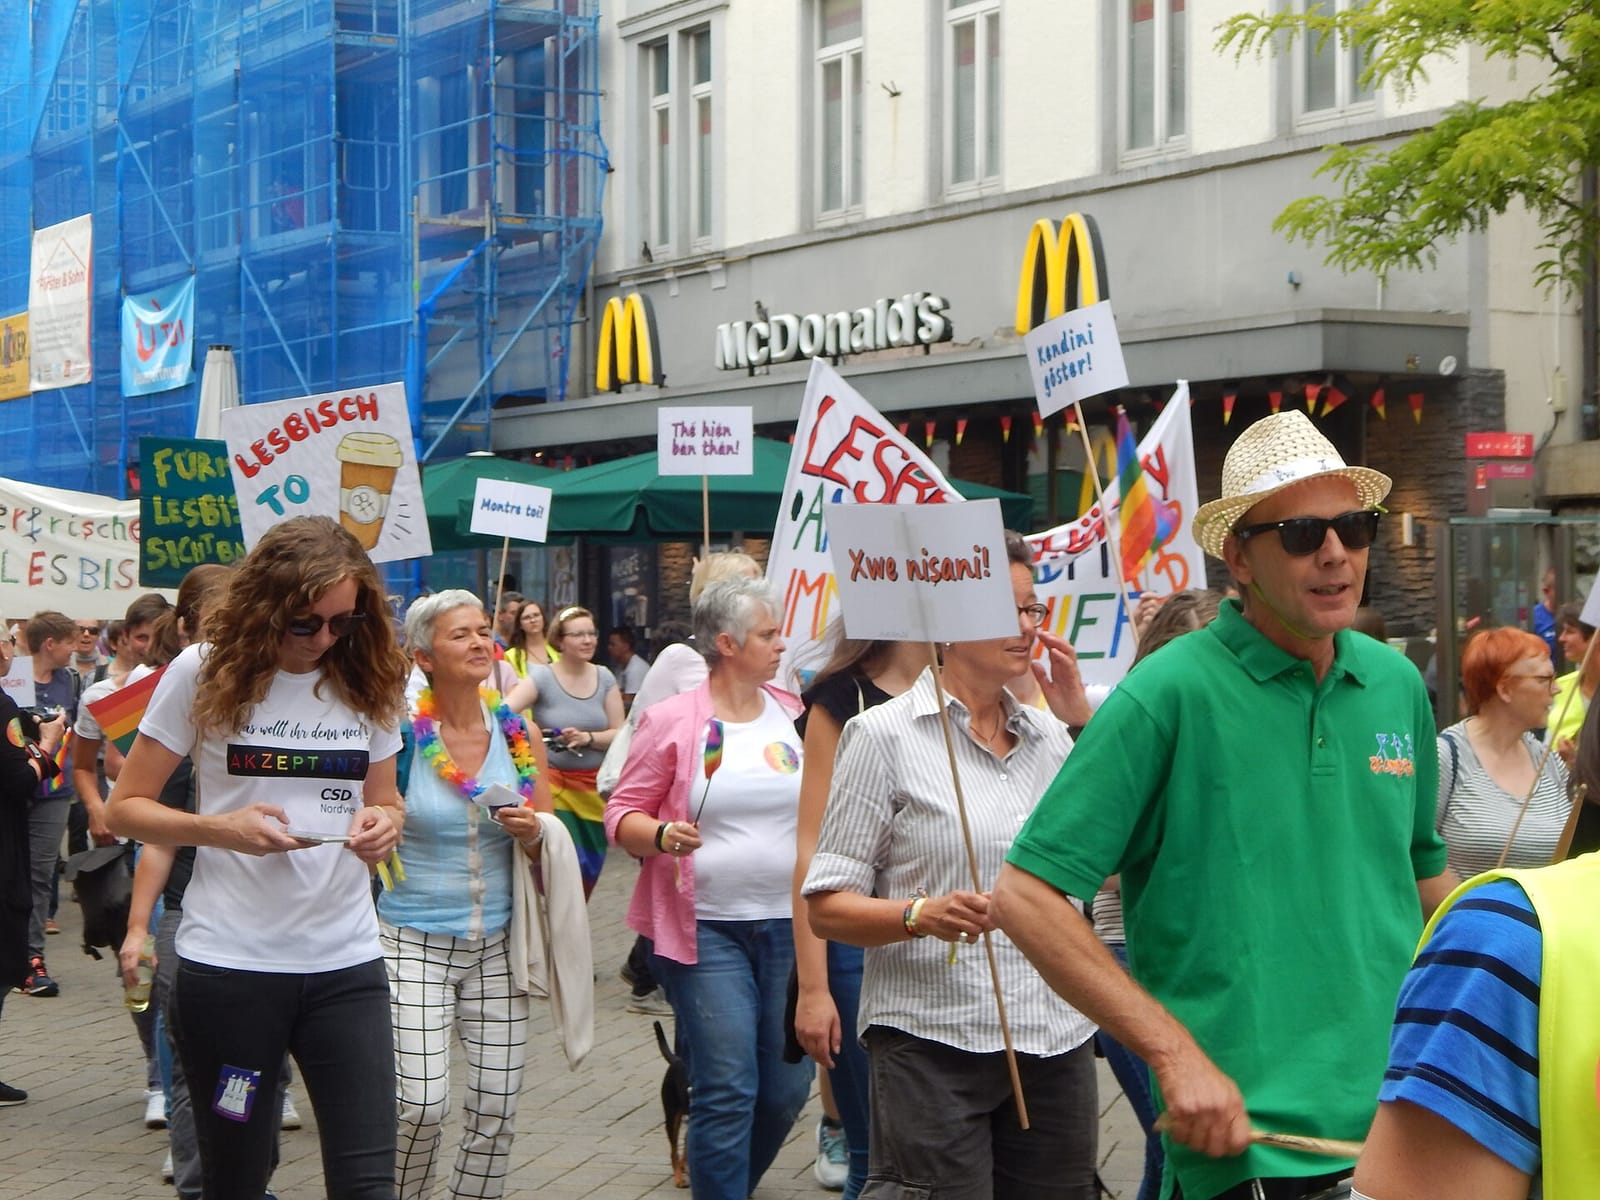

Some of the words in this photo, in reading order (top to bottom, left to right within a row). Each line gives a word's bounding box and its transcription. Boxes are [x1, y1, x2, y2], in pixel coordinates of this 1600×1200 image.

[714, 291, 950, 371] McDonald's
[1037, 322, 1094, 366] Kendini
[234, 393, 379, 478] LESBISCH
[256, 474, 310, 516] TO
[481, 498, 521, 515] Montre
[1, 550, 135, 590] LESBIS
[848, 548, 898, 582] Xwe
[290, 722, 308, 738] ihr
[311, 722, 338, 740] denn
[231, 753, 361, 773] AKZEPTANZ
[320, 788, 352, 801] CSD
